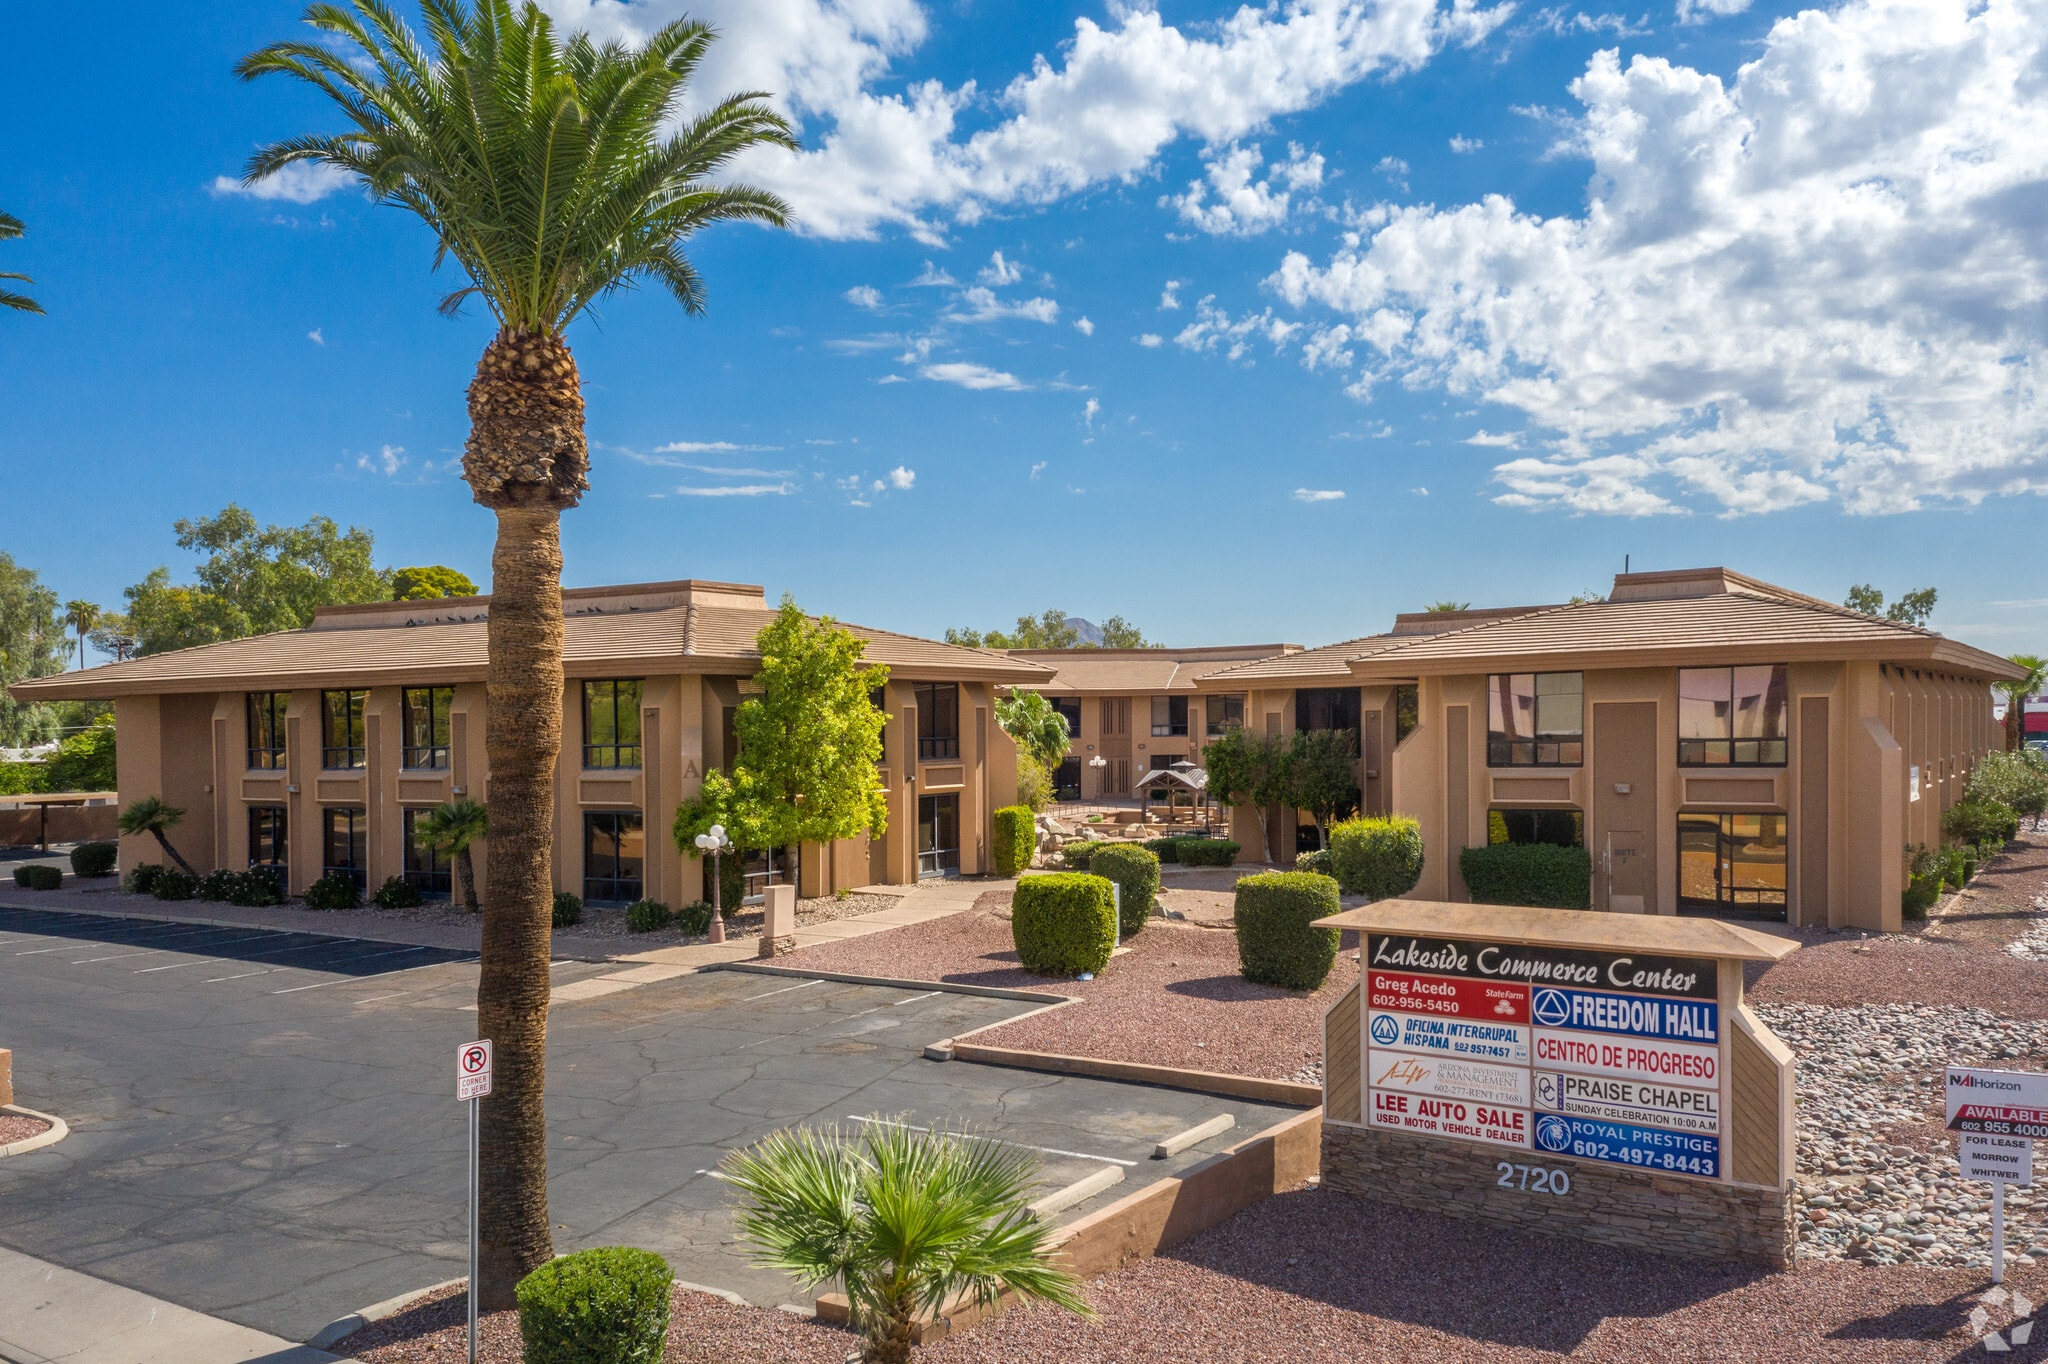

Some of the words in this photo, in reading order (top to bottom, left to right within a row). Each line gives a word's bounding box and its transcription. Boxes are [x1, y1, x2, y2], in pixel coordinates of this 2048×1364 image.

[1373, 936, 1468, 971] Lakeside
[1477, 947, 1598, 983] Commerce
[1608, 958, 1697, 991] Center
[1375, 976, 1409, 994] Greg
[1412, 980, 1456, 996] Acedo
[1372, 994, 1459, 1013] 602-956-5450
[1572, 995, 1660, 1033] FREEDOM
[1665, 1004, 1715, 1039] HALL
[1406, 1018, 1444, 1035] OFICINA
[1447, 1023, 1519, 1043] INTERGRUPAL
[1403, 1033, 1449, 1050] HISPANA
[1454, 1042, 1469, 1051] 602
[1470, 1044, 1510, 1057] 957-7457
[1537, 1037, 1598, 1065] CENTRO
[1602, 1045, 1623, 1068] DE
[1627, 1048, 1715, 1079] PROGRESO
[462, 1076, 487, 1087] CORNER
[1437, 1063, 1470, 1073] ARIZONA
[1472, 1067, 1519, 1079] INVESTMENT
[1446, 1072, 1519, 1087] MANAGEMENT
[471, 1084, 487, 1093] HERE
[1434, 1084, 1494, 1099] 602-277-RENT
[1495, 1093, 1523, 1104] (7368)
[1565, 1077, 1633, 1102] PRAISE
[1638, 1086, 1717, 1113] CHAPEL
[1376, 1093, 1408, 1113] LEE
[1418, 1099, 1467, 1122] AUTO
[1476, 1107, 1525, 1130] SALE
[1565, 1102, 1602, 1115] SUNDAY
[1604, 1107, 1670, 1125] CELEBRATION
[1672, 1117, 1697, 1127] 10:00
[1965, 1106, 2048, 1123] AVAILABLE
[1376, 1113, 1400, 1124] USED
[1404, 1117, 1437, 1130] MOTOR
[1442, 1122, 1481, 1137] VEHICLE
[1486, 1129, 1525, 1143] DEALER
[1572, 1121, 1627, 1140] ROYAL
[1632, 1130, 1712, 1152] PRESTIGE
[1961, 1121, 1981, 1131] 602
[1984, 1121, 2010, 1133] 955
[2014, 1124, 2048, 1137] 4000
[1966, 1136, 1988, 1145] FOR
[1991, 1138, 2026, 1148] LEASE
[1573, 1140, 1714, 1175] 602-497-8443
[1972, 1152, 2019, 1163] MORROW
[1497, 1161, 1570, 1195] 2720
[1971, 1168, 2020, 1179] WHITWER
